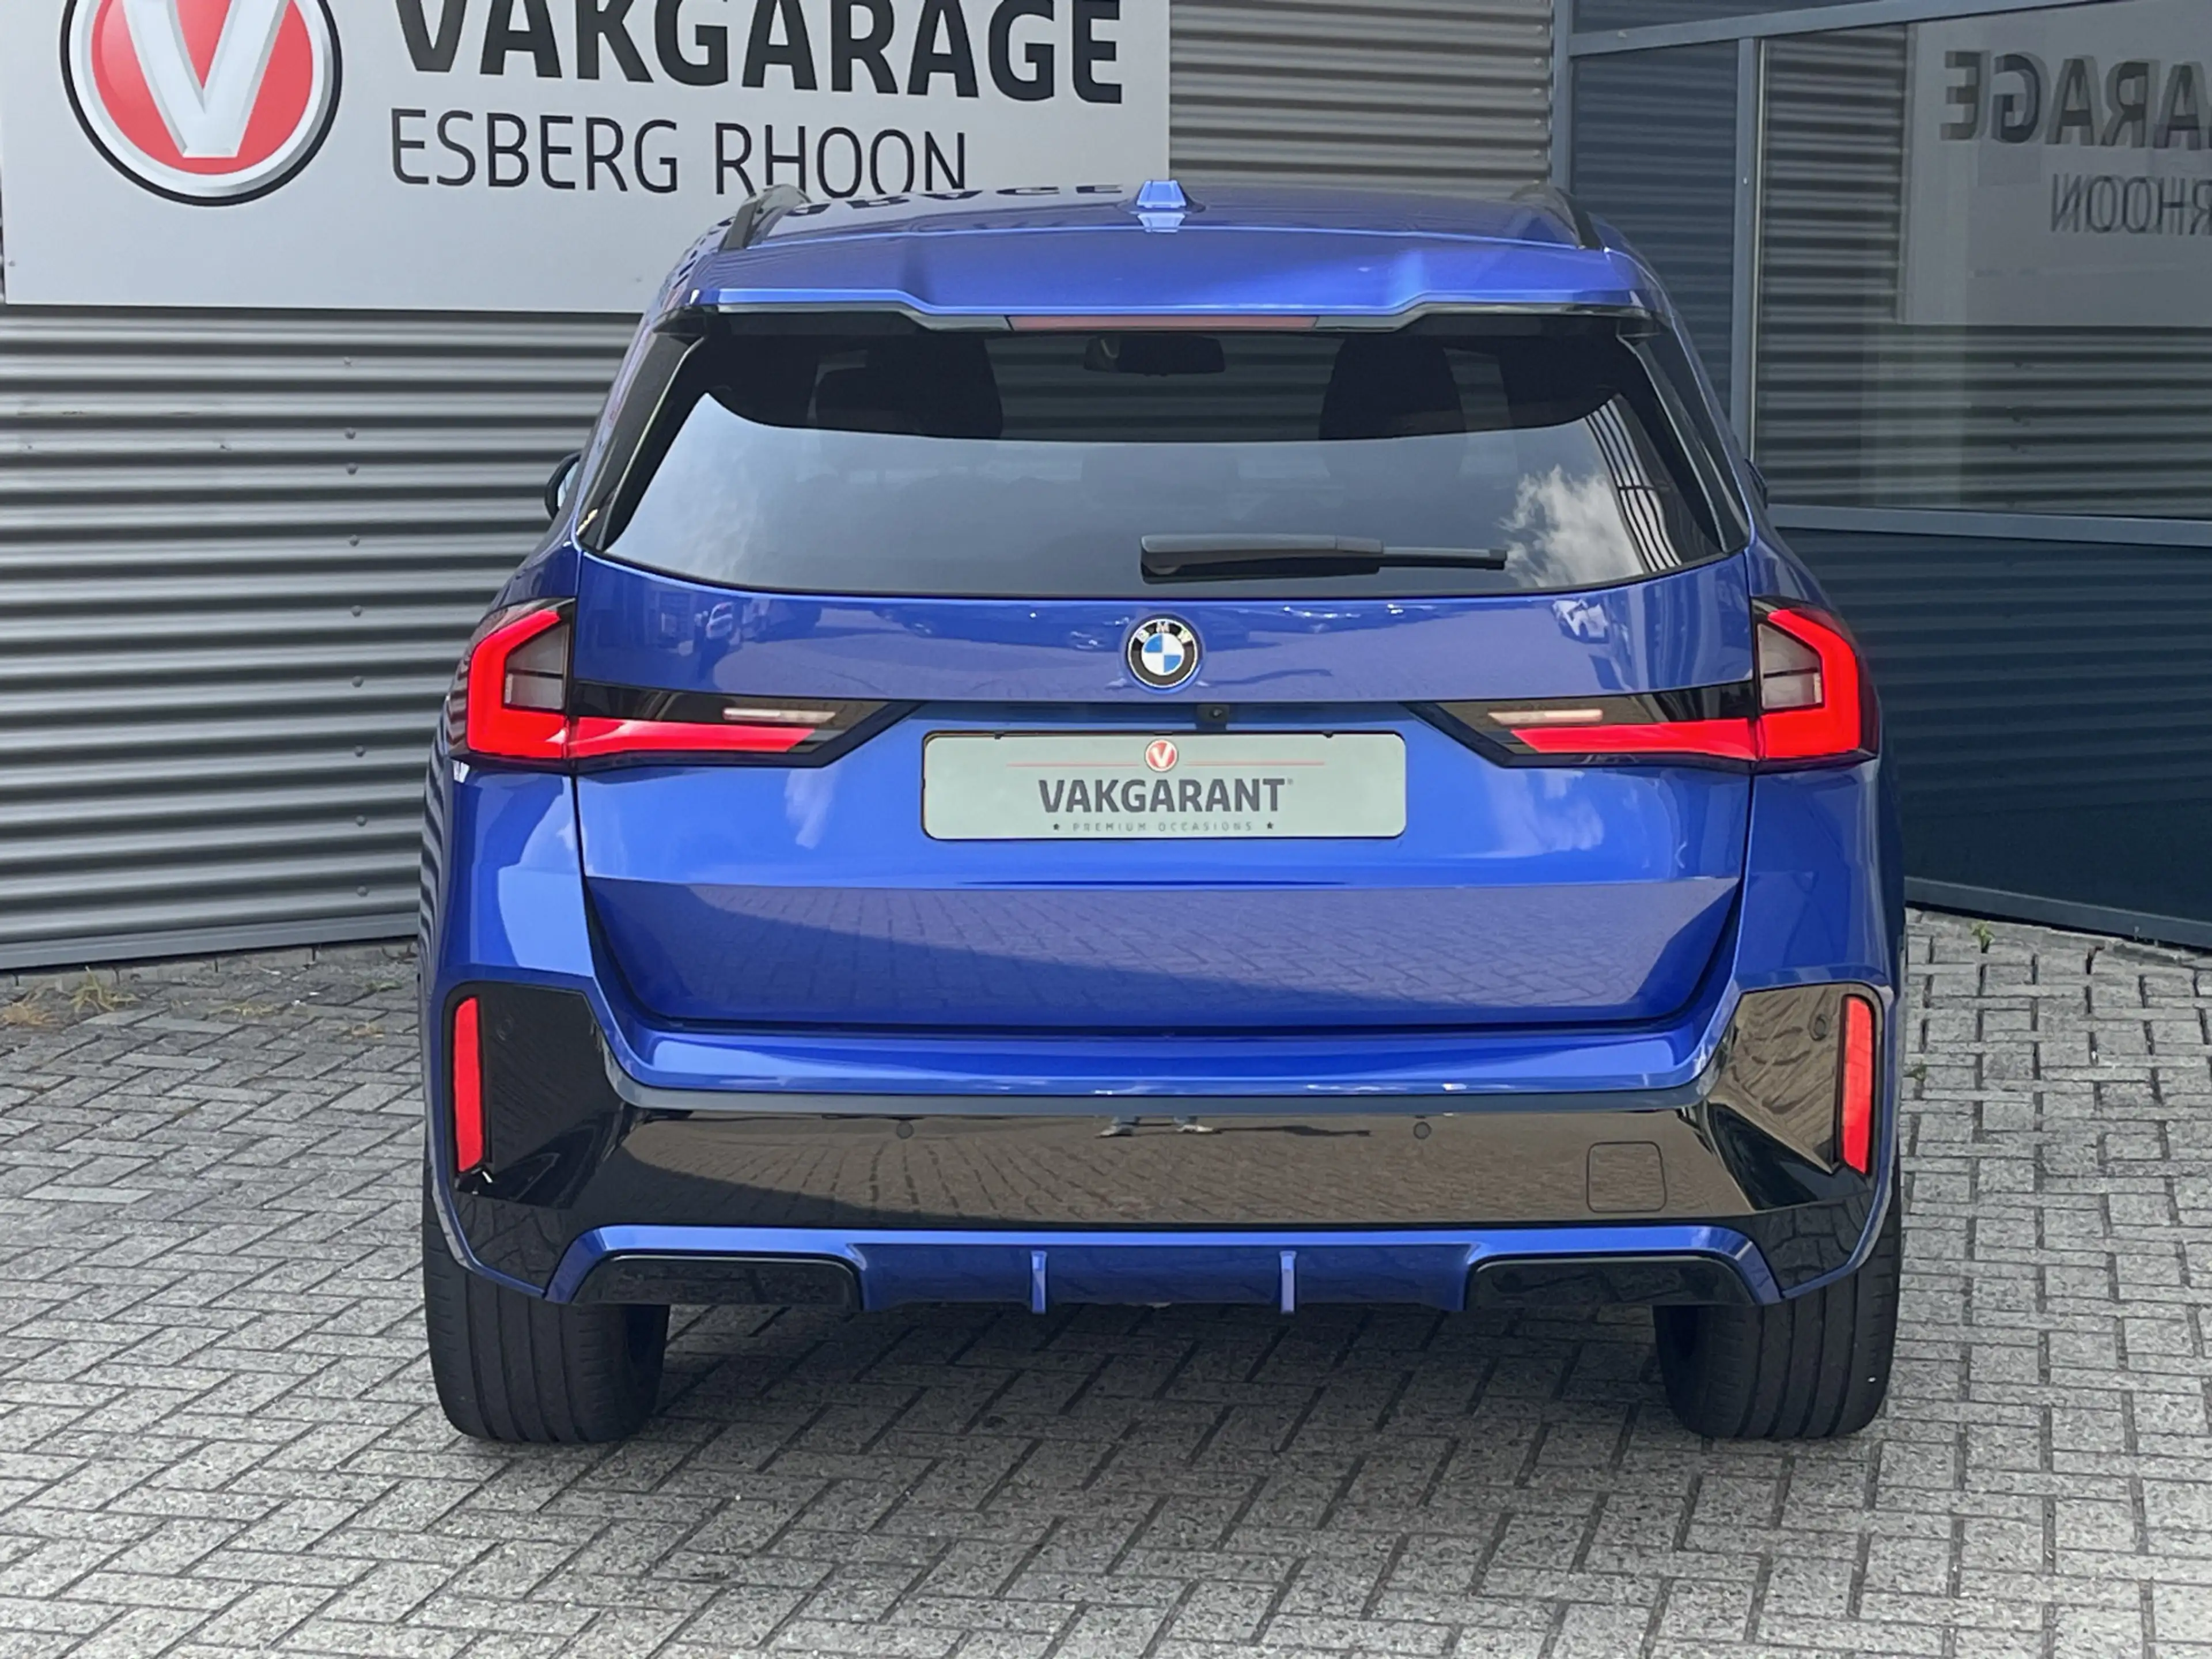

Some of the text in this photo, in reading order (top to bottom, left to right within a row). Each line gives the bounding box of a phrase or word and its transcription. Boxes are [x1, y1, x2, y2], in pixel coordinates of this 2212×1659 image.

[395, 0, 1122, 104] VAKGARAGE
[391, 108, 965, 198] ESBERG RHOON
[1038, 778, 1285, 813] VAKGARANT
[1072, 821, 1252, 832] PREMIUM OCCASIONS
